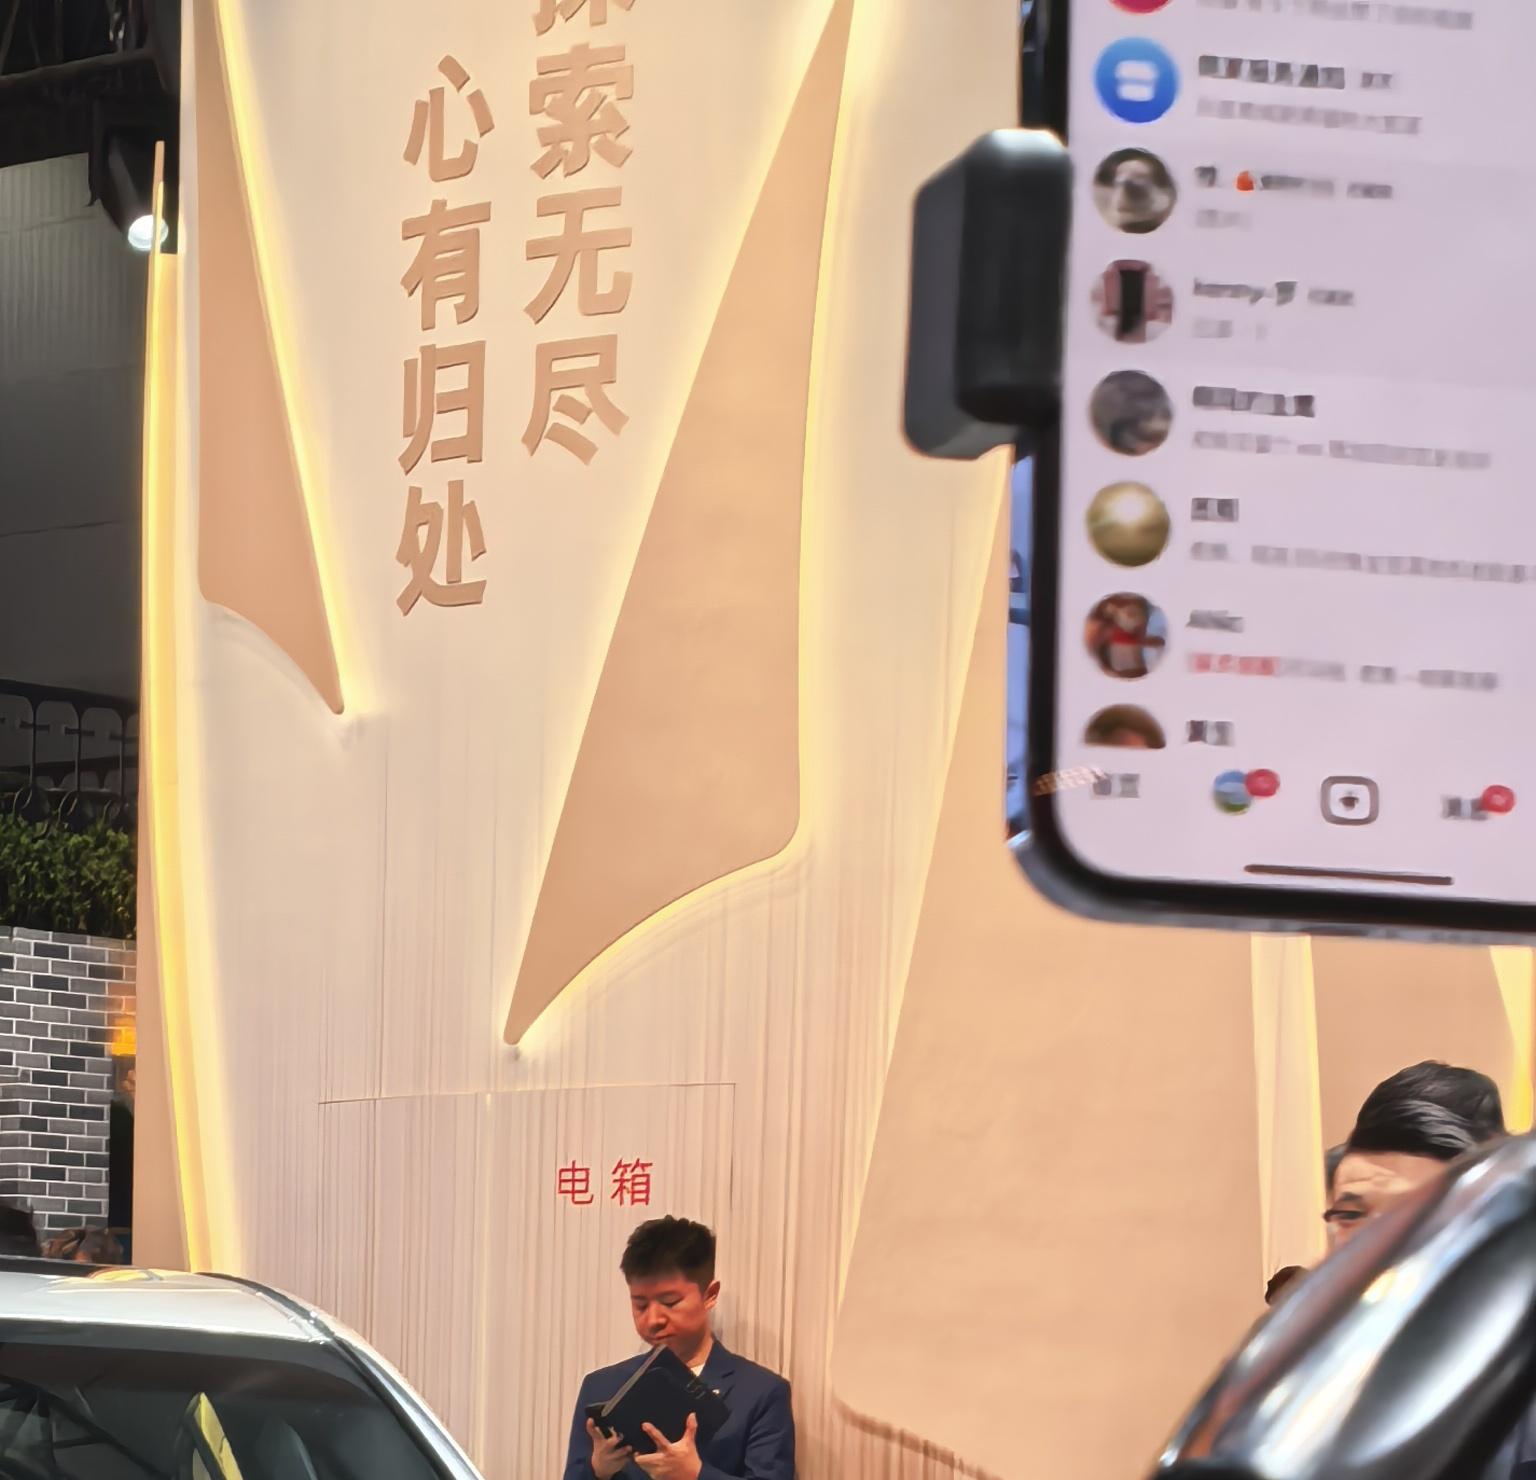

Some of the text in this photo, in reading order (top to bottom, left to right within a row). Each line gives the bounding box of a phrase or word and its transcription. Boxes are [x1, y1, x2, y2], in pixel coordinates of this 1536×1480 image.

[395, 54, 495, 617] 心有归处
[520, 0, 637, 466] 索无尽
[556, 1157, 654, 1207] 电箱
